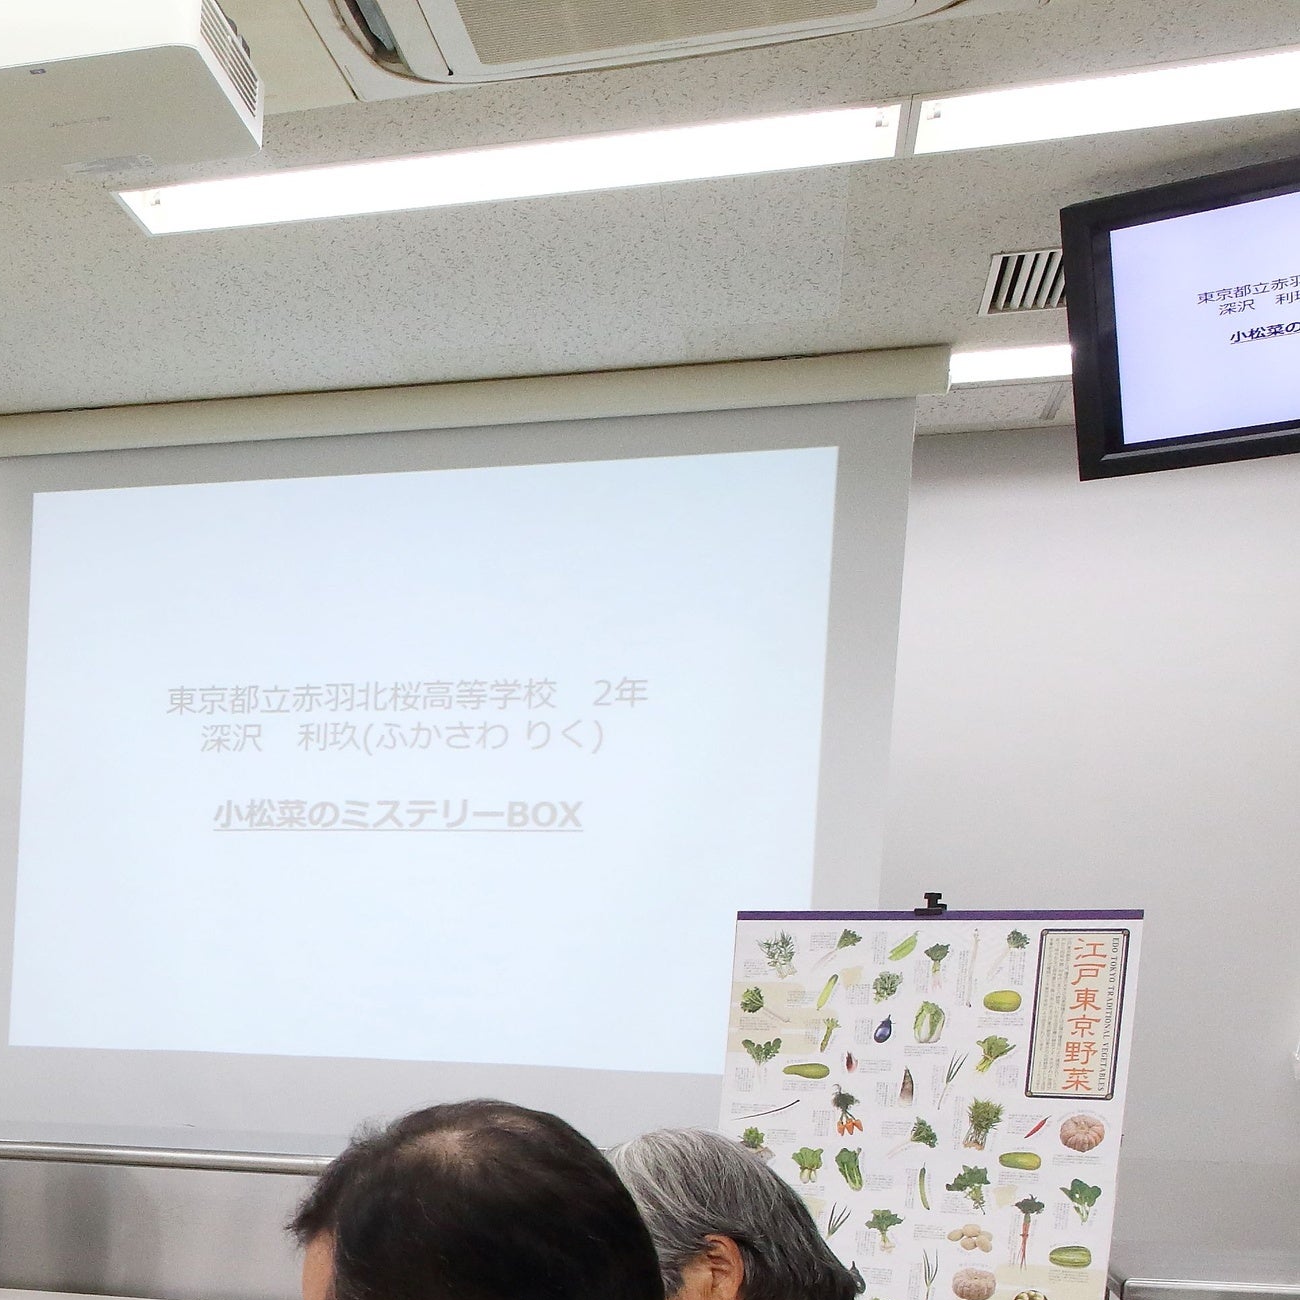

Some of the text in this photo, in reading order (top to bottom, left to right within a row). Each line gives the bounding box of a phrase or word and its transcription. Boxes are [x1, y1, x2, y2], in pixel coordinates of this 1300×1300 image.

[1219, 299, 1255, 315] 深沢
[166, 677, 649, 716] 東京都立赤羽北桜高等学校 2年
[200, 719, 604, 755] 深沢 利玖(ふかさわ りく)
[213, 799, 584, 831] 小松菜のミステリーBOX
[1111, 937, 1120, 953] EDO
[1108, 956, 1117, 983] TOKYO
[1062, 938, 1107, 1091] 江戸東京野菜
[1104, 986, 1115, 1038] TRADITIONAL
